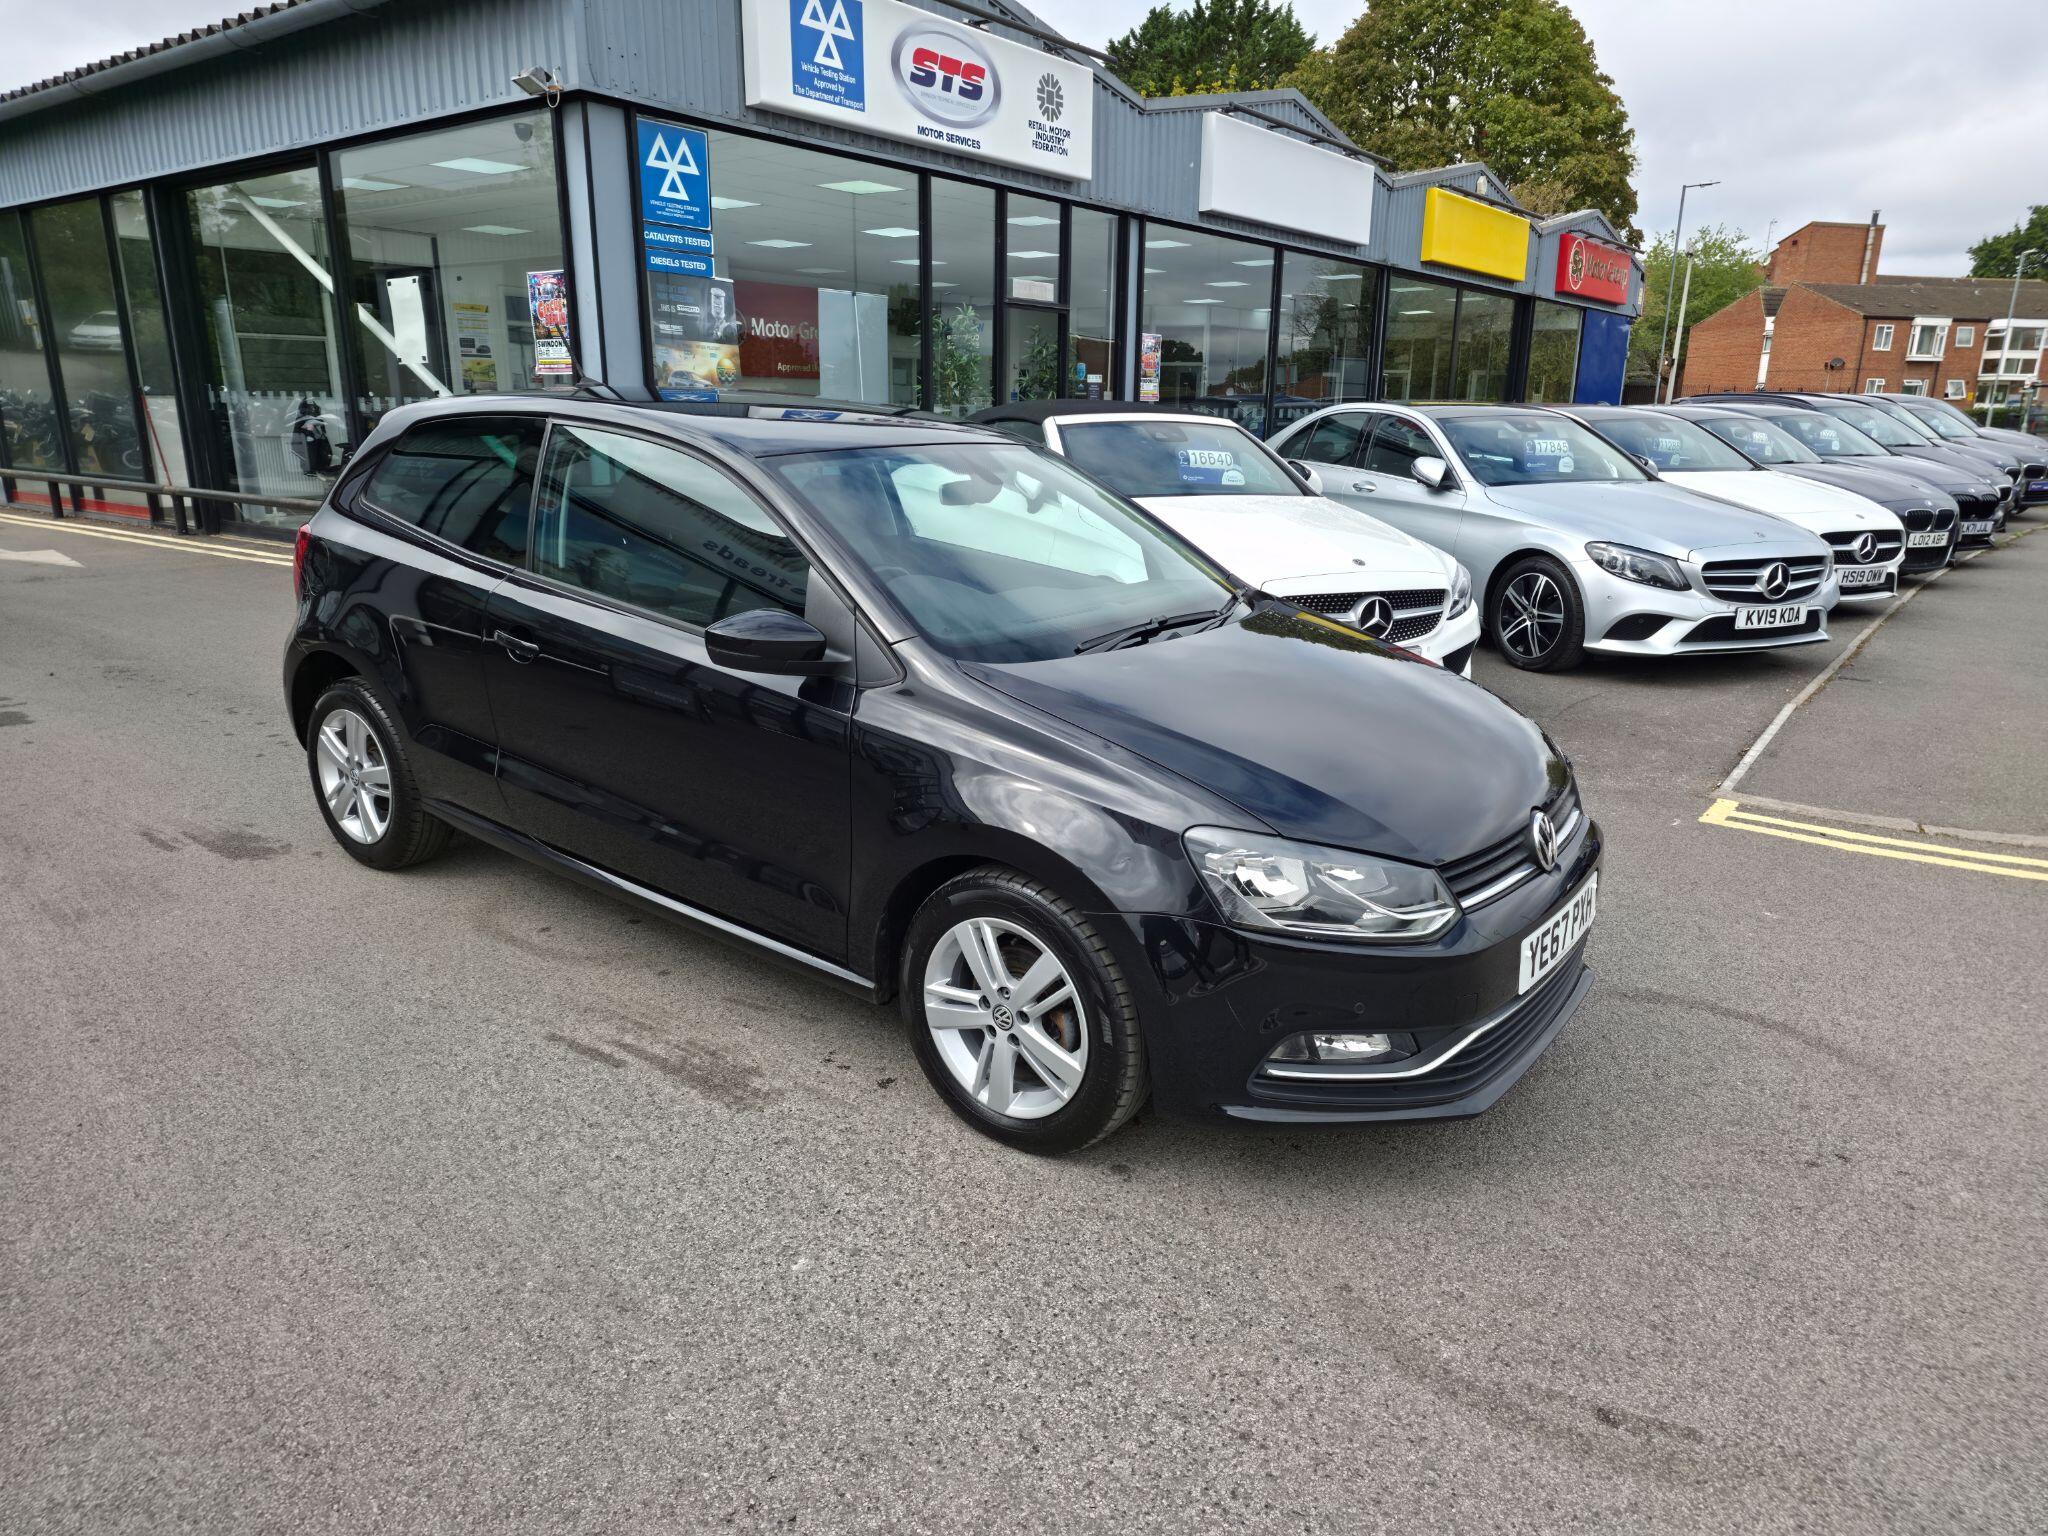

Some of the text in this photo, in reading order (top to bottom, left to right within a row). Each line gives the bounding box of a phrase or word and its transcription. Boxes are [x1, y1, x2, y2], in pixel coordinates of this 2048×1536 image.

[801, 61, 856, 84] Vehicle Testing Station
[910, 47, 986, 101] STS
[814, 78, 845, 95] Approved by
[795, 85, 804, 95] The
[806, 88, 834, 103] Department
[841, 97, 864, 110] Transport
[917, 125, 981, 150] MOTOR SERVICES
[1028, 120, 1071, 139] RETAIL MOTOR
[1032, 140, 1068, 156] FEDERATION
[1035, 131, 1065, 147] INDUSTRY
[644, 230, 710, 248] CATALYSTS TESTED
[650, 256, 706, 271] DIESELS TESTED
[751, 317, 795, 338] Motor
[538, 340, 563, 348] SWINDON
[1178, 450, 1233, 467] £16640
[1841, 570, 1865, 583] HS19
[1745, 606, 1801, 626] KV19 KDA
[1530, 910, 1570, 978] YE67
